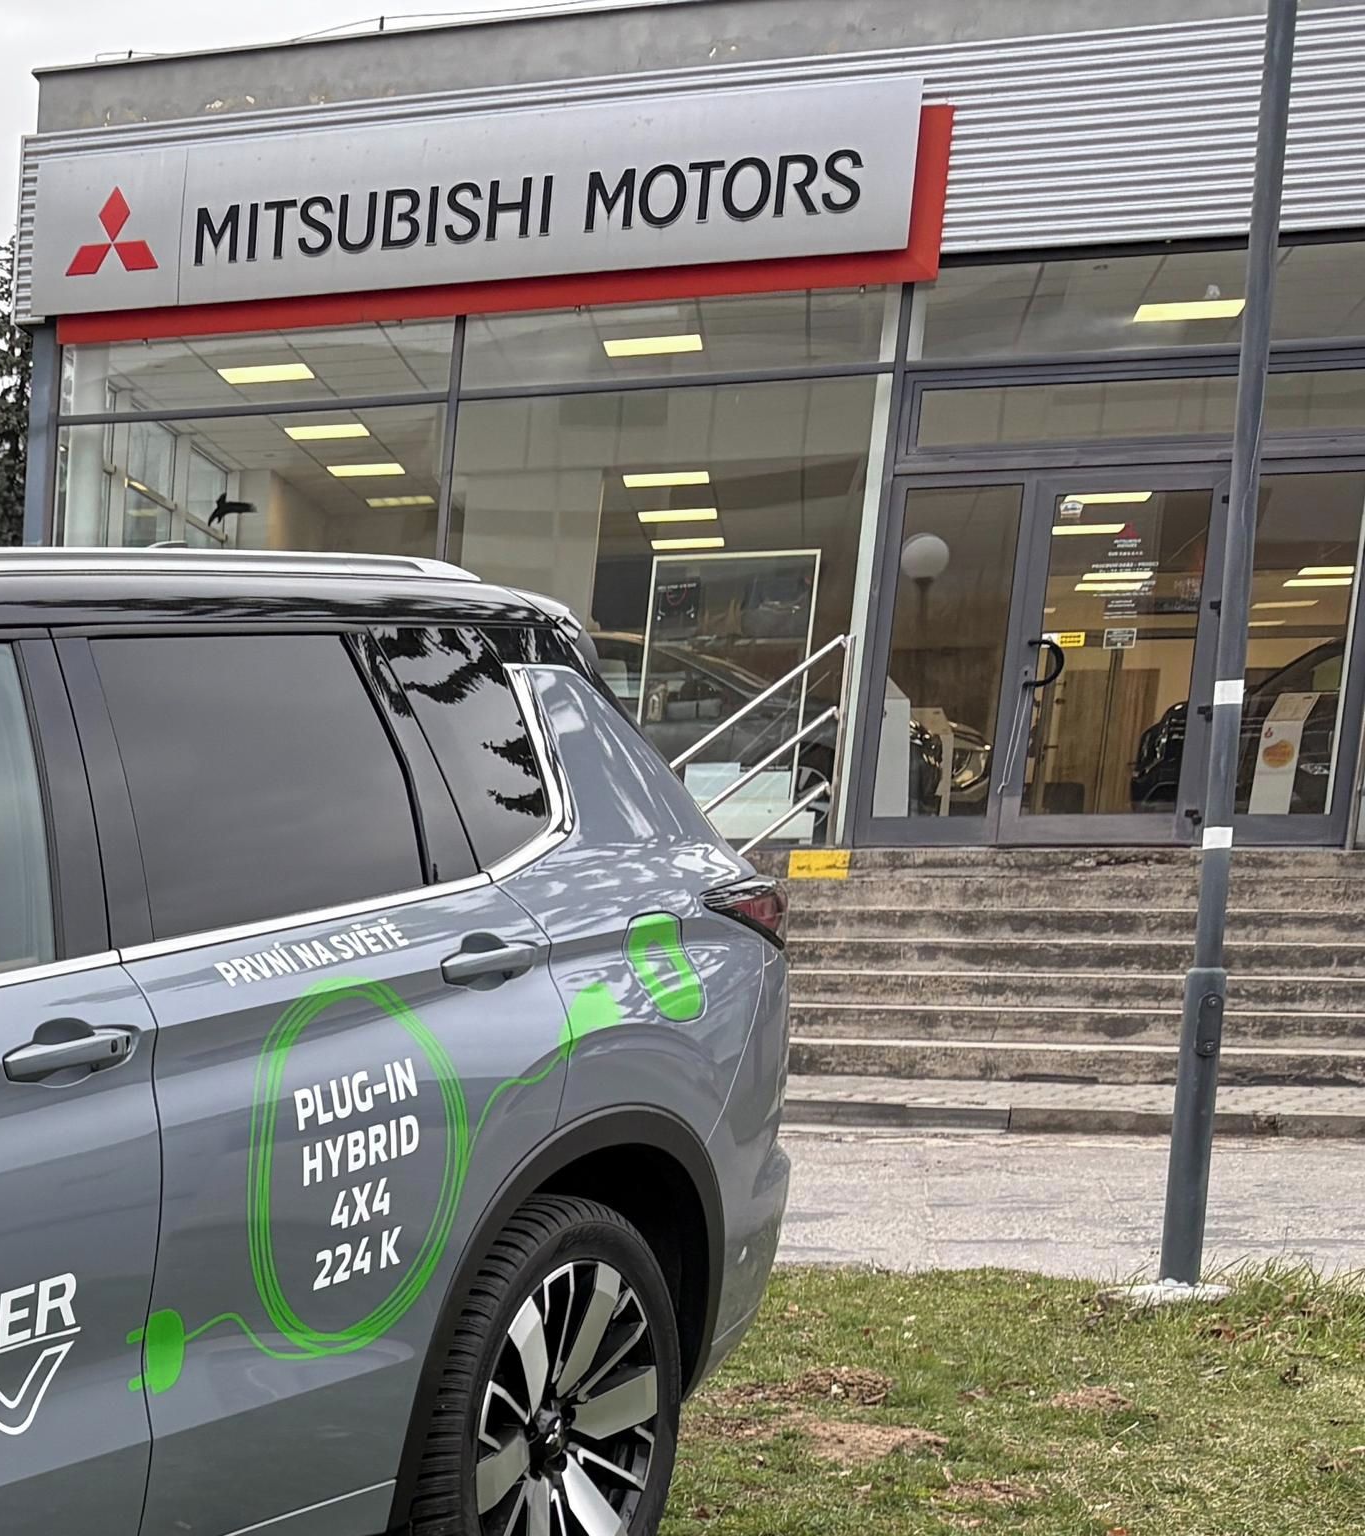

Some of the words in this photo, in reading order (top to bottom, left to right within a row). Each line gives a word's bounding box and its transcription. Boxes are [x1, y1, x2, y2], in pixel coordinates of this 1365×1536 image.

[193, 175, 554, 267] MITSUBISHI
[583, 149, 864, 233] MOTORS
[214, 942, 300, 988] PRVNÍ
[291, 940, 339, 969] NA
[329, 917, 409, 960] SVĚTĚ
[293, 1058, 419, 1132] PLUG-IN
[301, 1114, 420, 1187] HYBRID
[329, 1177, 391, 1230] 4X4
[312, 1245, 373, 1292] 224
[378, 1225, 401, 1270] K
